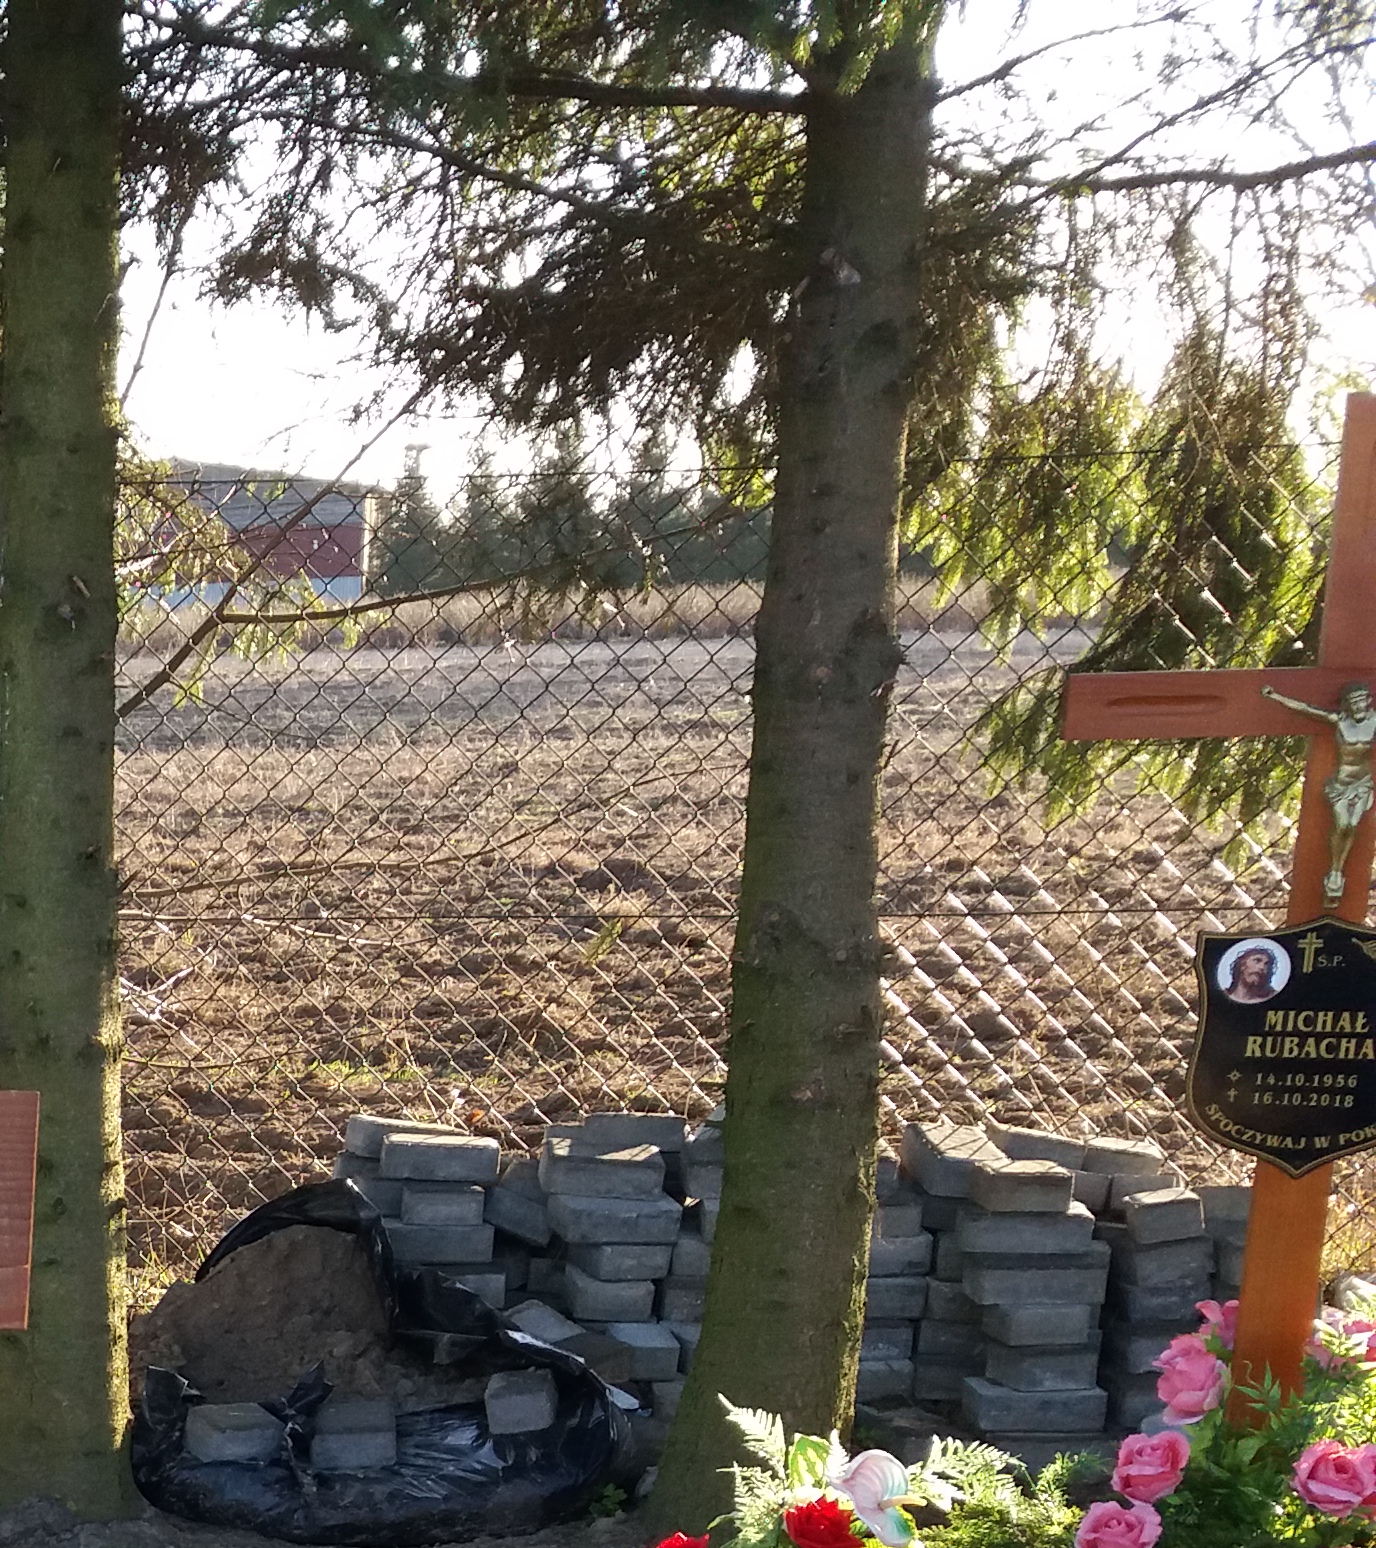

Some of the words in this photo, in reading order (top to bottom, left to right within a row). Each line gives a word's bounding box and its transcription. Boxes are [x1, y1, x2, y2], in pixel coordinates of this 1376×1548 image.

[1264, 1010, 1369, 1033] MICHAŁ
[1244, 1035, 1375, 1060] RUBACHA
[1254, 1072, 1358, 1088] 14.10.1956
[1252, 1092, 1355, 1108] 16.10.2018
[1205, 1103, 1306, 1149] SPOCZYWAJ
[1314, 1135, 1331, 1149] W
